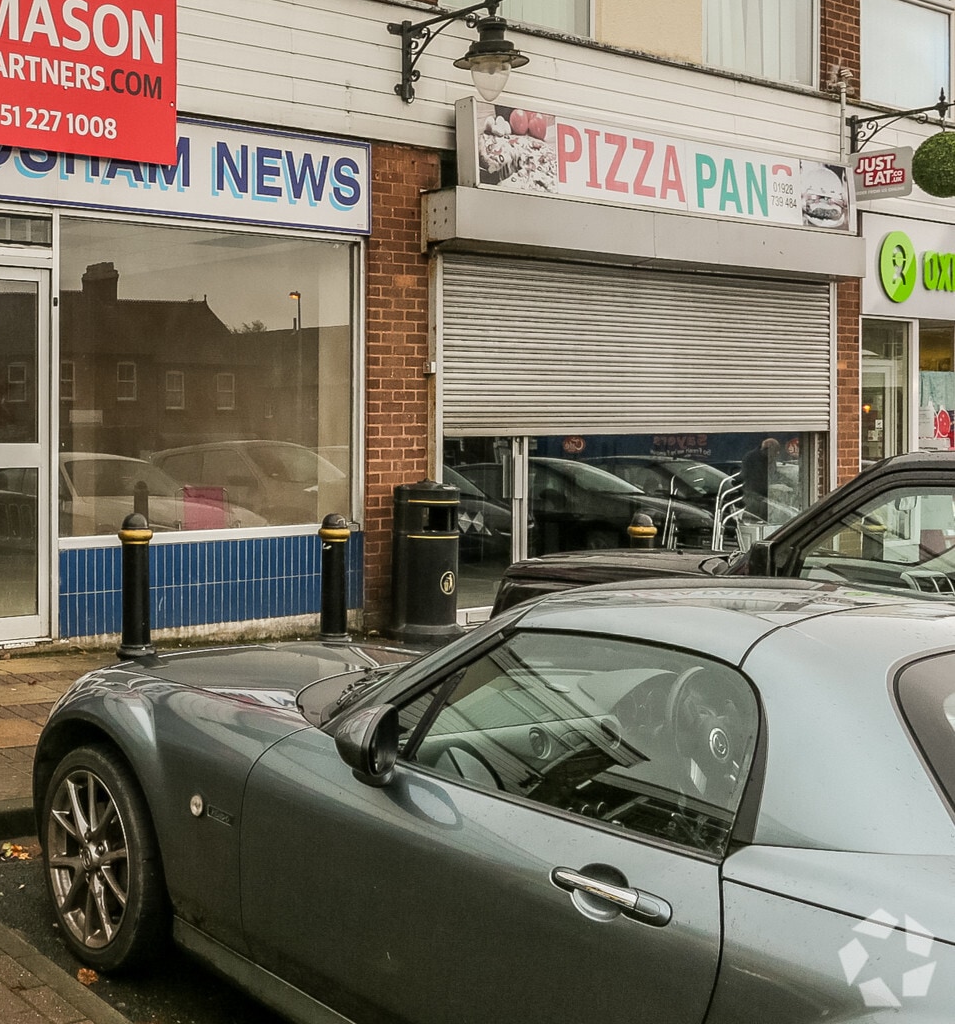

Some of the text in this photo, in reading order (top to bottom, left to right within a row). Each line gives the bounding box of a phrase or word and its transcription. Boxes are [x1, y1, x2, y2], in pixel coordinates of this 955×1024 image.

[25, 107, 62, 132] 227
[66, 112, 118, 140] 1008
[211, 141, 362, 212] NEWS
[556, 123, 769, 217] PIZZA PAN
[856, 155, 894, 173] JUST
[773, 182, 794, 195] 01928
[771, 195, 797, 209] 739 484
